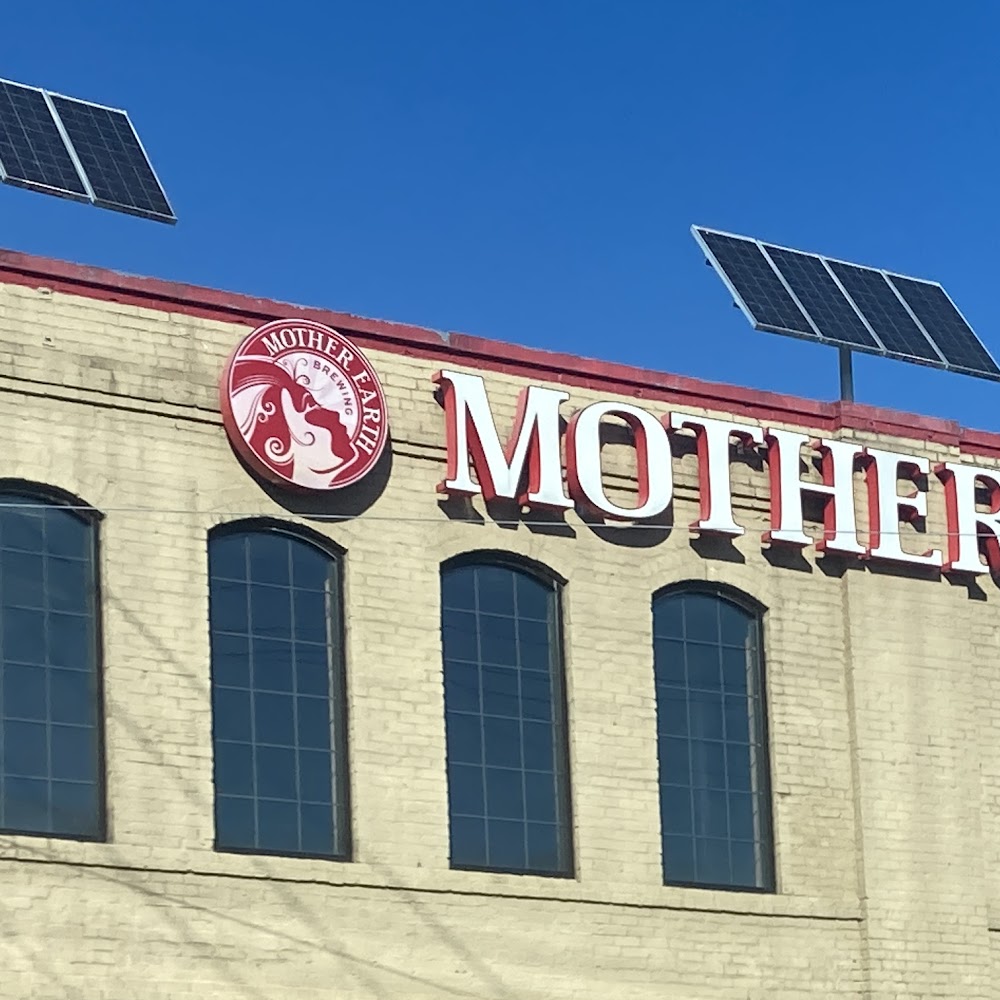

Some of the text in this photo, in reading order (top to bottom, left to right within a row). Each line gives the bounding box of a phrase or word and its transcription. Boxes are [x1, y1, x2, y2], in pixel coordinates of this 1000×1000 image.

[261, 328, 381, 455] MOTHER EARTH
[313, 360, 353, 416] BREWING
